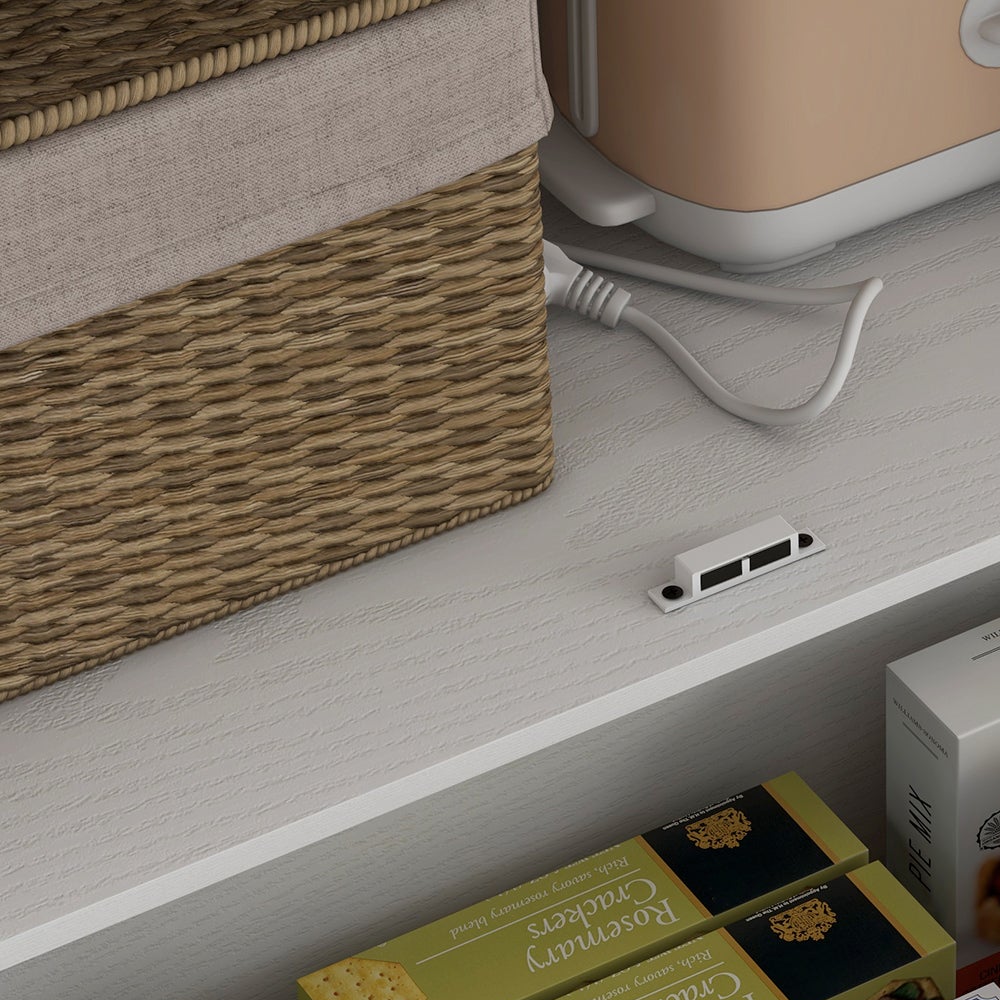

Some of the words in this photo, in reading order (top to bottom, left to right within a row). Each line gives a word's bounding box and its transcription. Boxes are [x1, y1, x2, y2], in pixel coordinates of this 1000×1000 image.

[908, 785, 932, 844] MIX
[594, 856, 629, 875] Rich,
[908, 838, 932, 893] PIE
[551, 873, 592, 893] savory
[490, 891, 549, 919] rosemary
[527, 877, 657, 940] Crackers
[448, 916, 489, 940] blend
[525, 897, 681, 973] Rosemary
[677, 949, 713, 969] Rich,
[633, 966, 676, 988] savory
